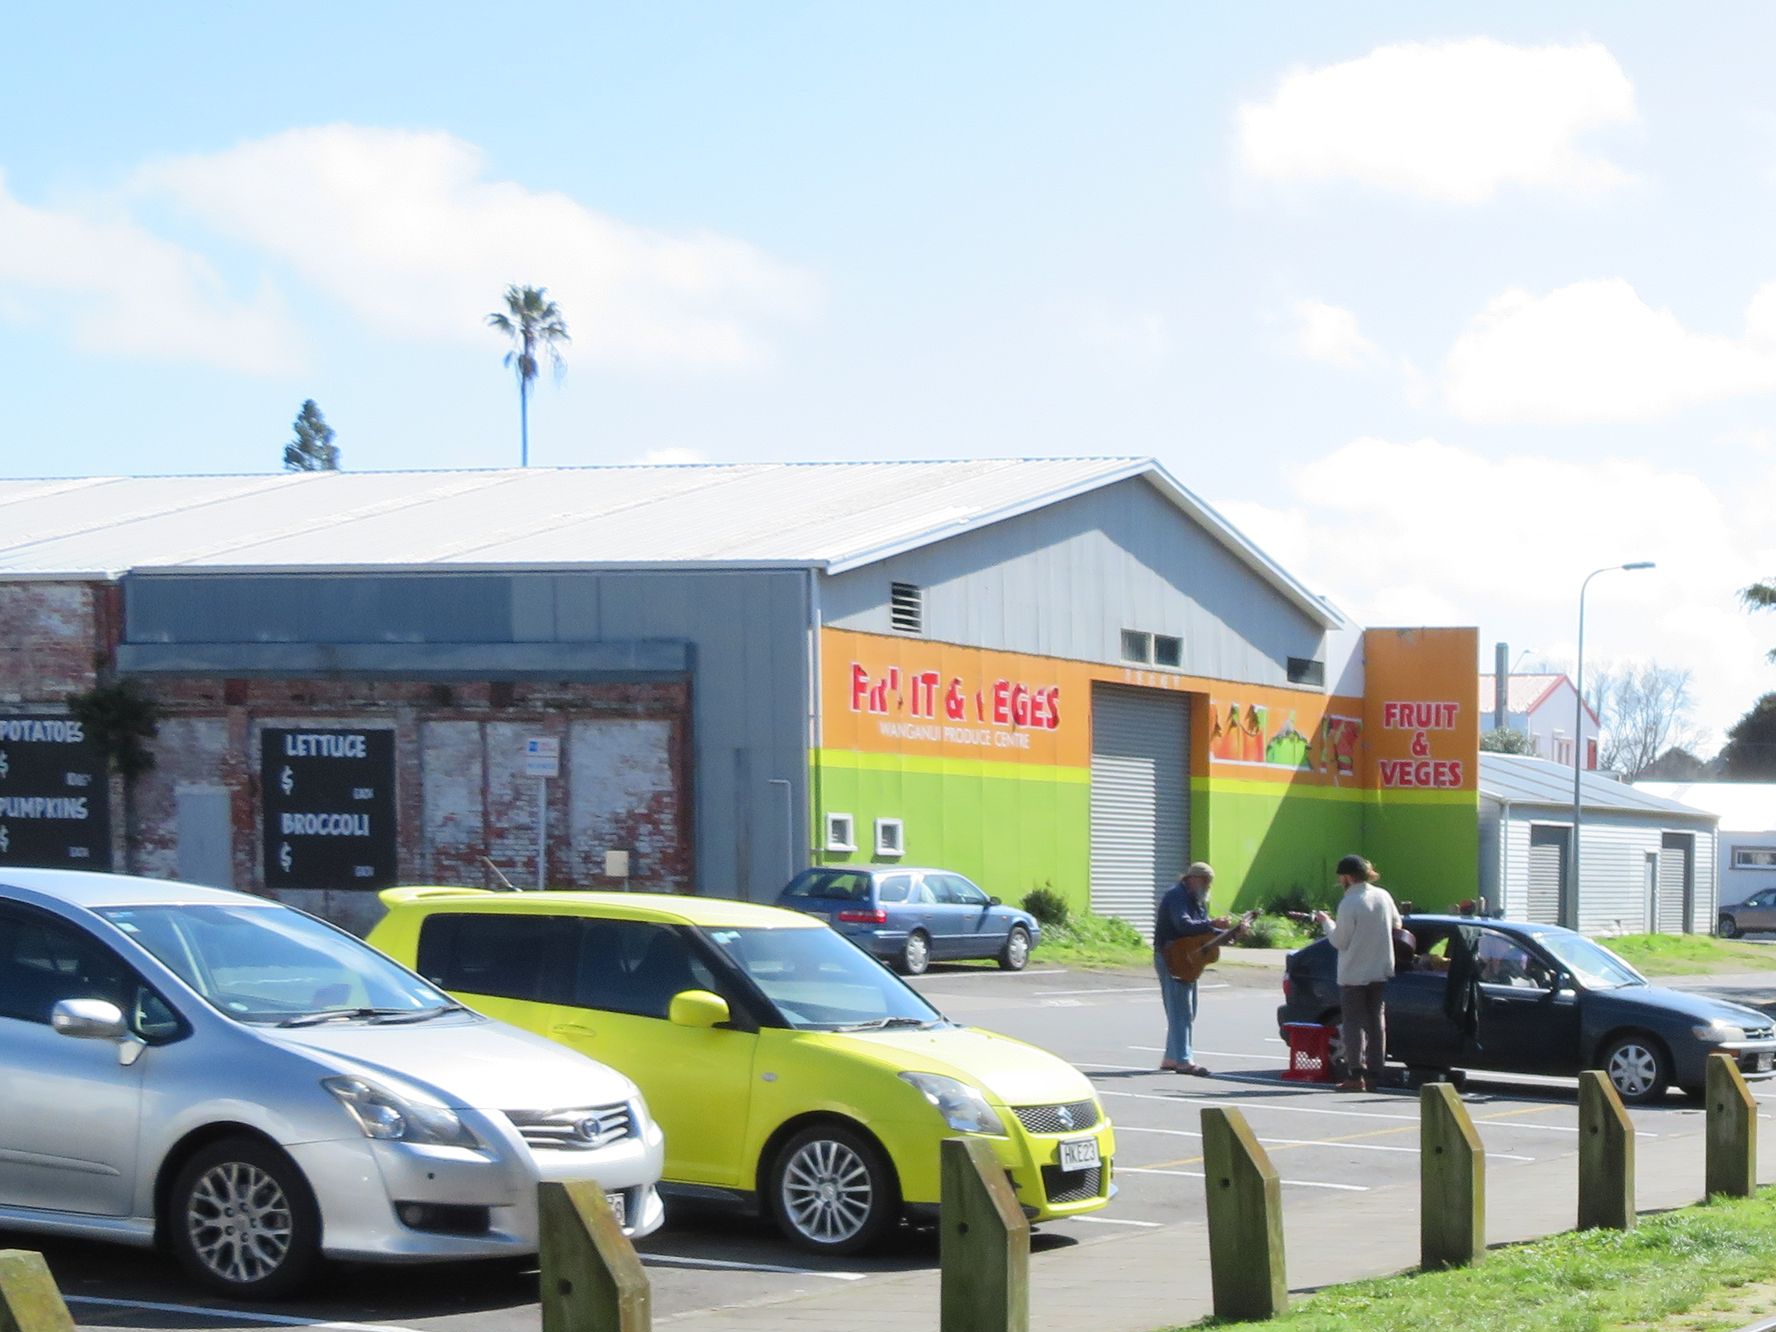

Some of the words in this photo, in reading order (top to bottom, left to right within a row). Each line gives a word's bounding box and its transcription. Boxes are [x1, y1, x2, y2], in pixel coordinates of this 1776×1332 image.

[850, 661, 940, 720] FIT
[975, 678, 1060, 732] EGES
[1384, 702, 1459, 729] FRUIT
[0, 720, 85, 743] POTATOES
[880, 721, 941, 741] WANGANUI
[944, 727, 992, 746] PRODUCE
[994, 731, 1030, 749] CENTRE
[1411, 730, 1430, 757] &
[285, 734, 367, 758] LETTUCE
[281, 765, 294, 795] $
[1379, 760, 1463, 788] VEGES
[0, 797, 88, 819] PUMPKINS
[281, 813, 369, 836] BROCCOLI
[280, 842, 292, 873] $
